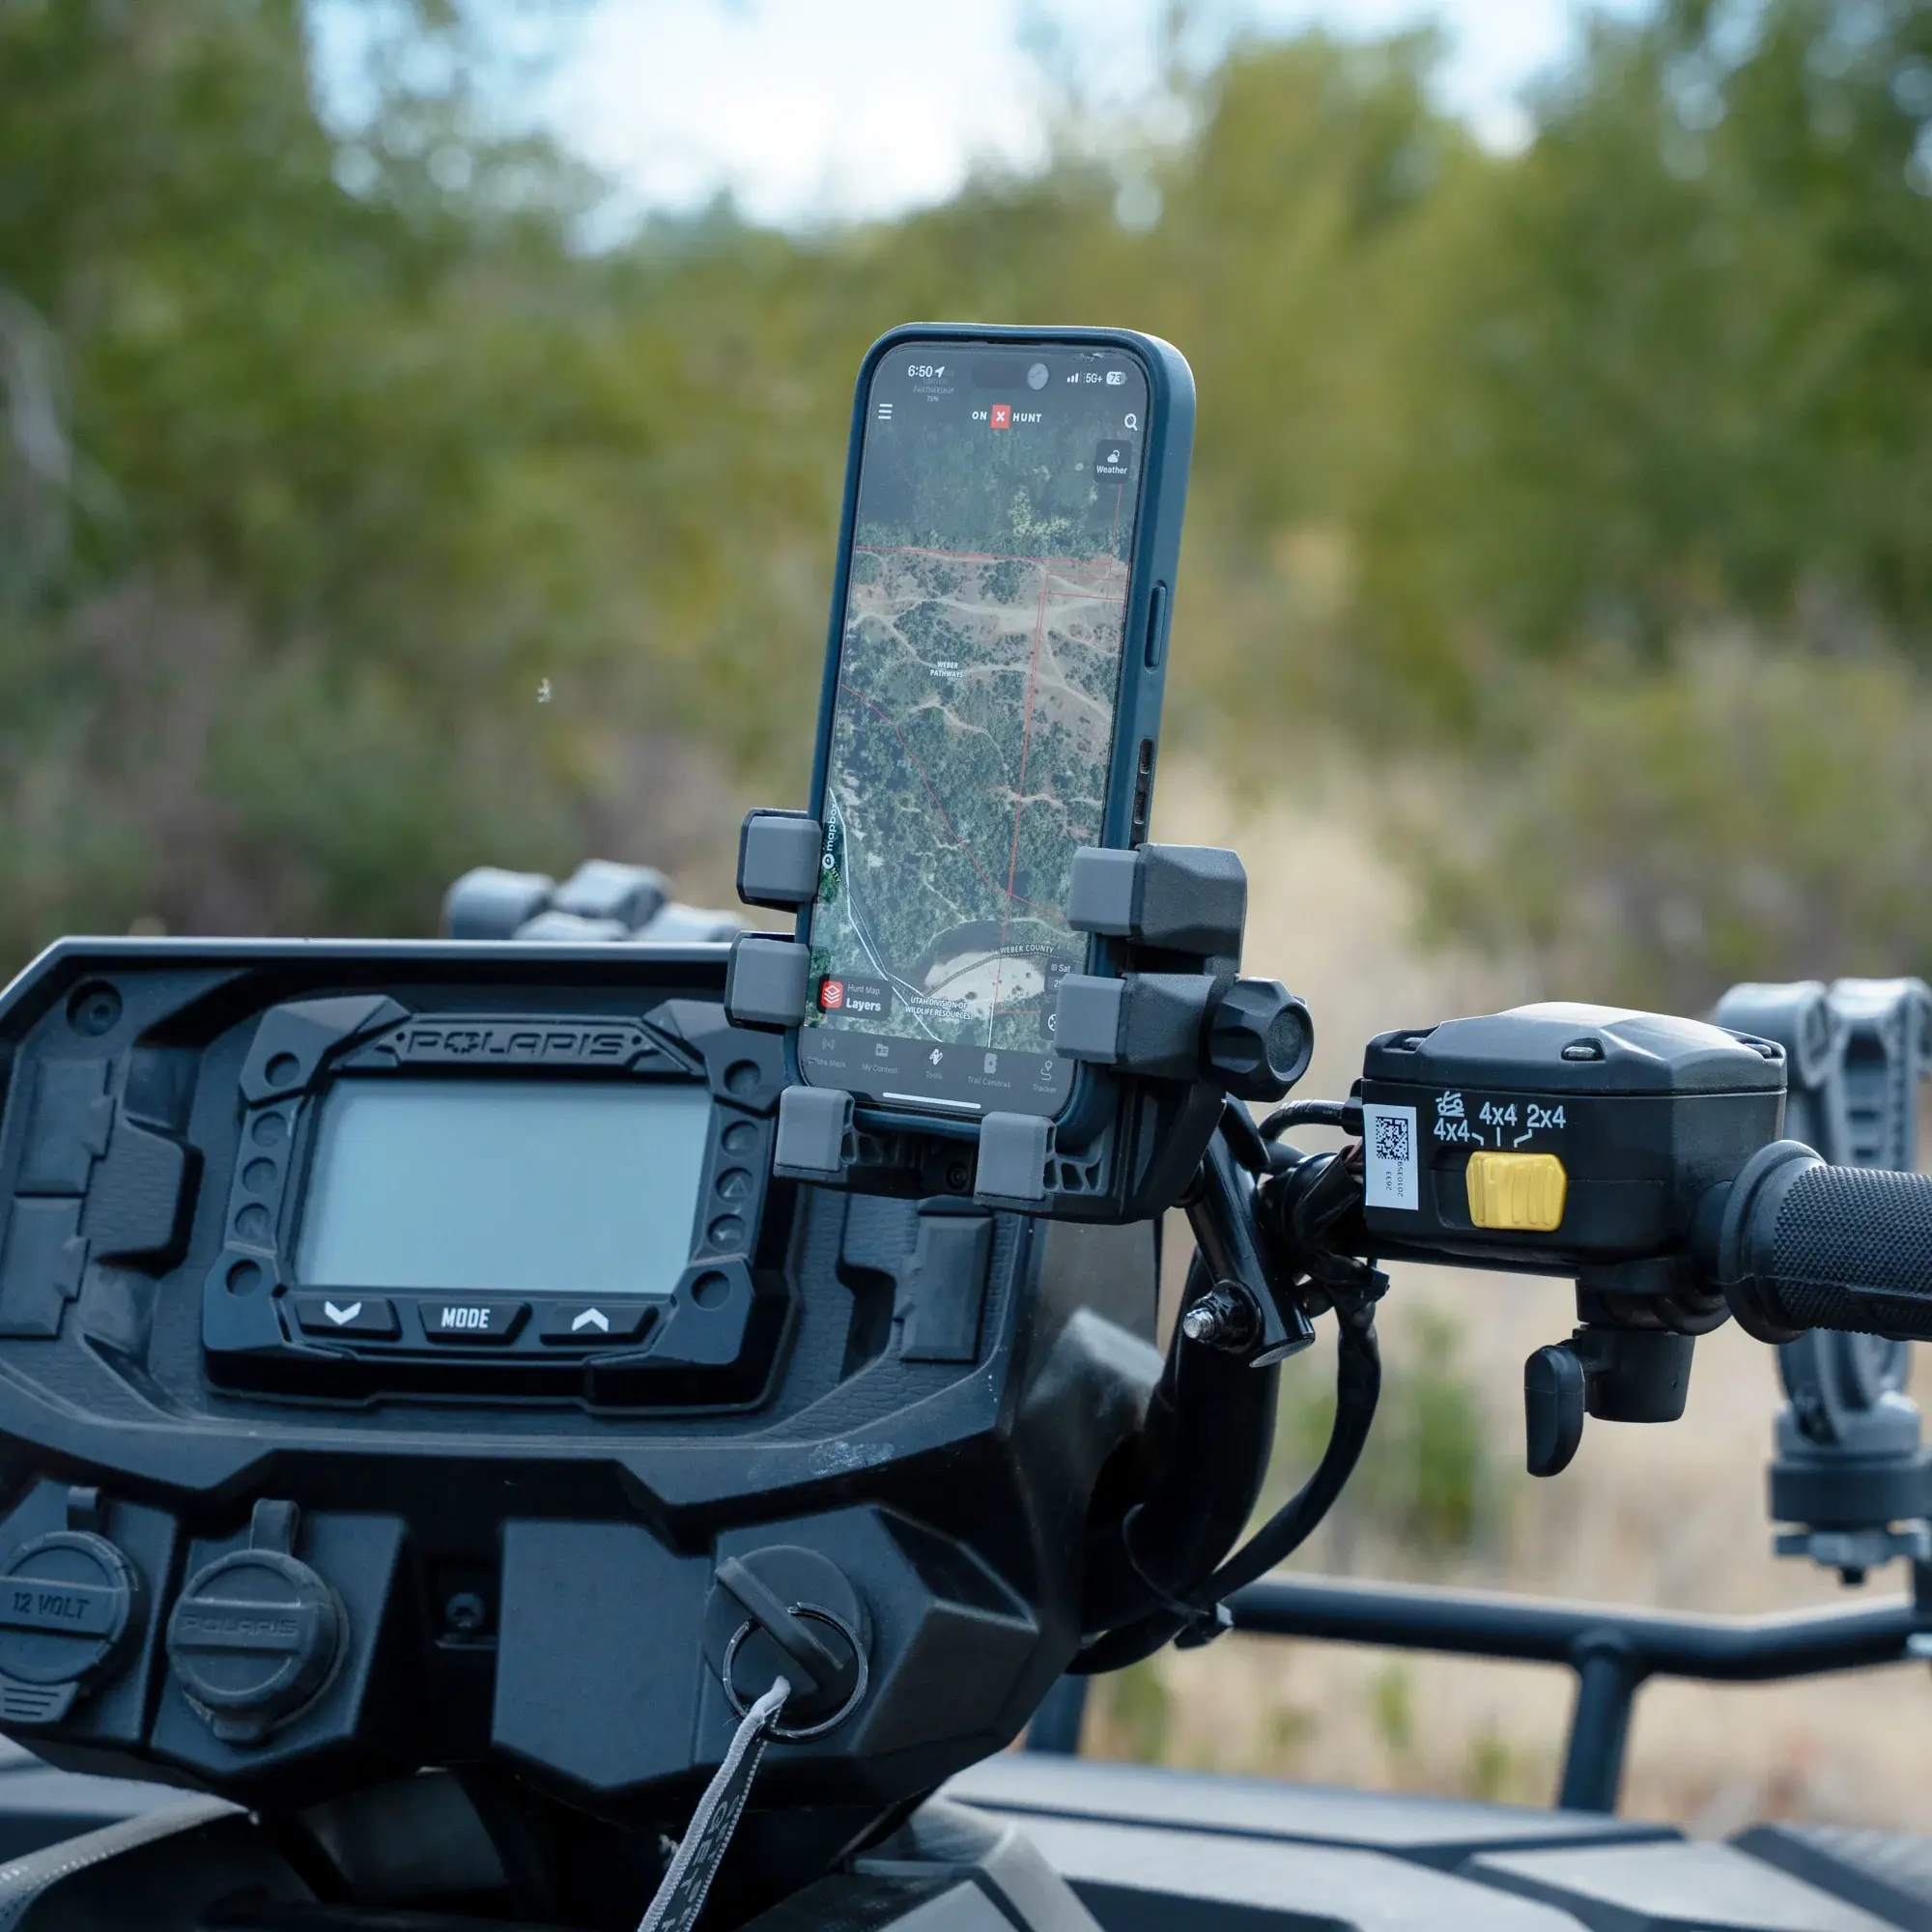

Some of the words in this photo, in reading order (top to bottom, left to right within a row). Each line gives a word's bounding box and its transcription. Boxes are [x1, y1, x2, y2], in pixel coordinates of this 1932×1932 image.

[908, 364, 933, 378] 6:50
[1086, 372, 1103, 384] 5G+
[972, 411, 987, 421] ON
[1012, 412, 1042, 423] HUNT
[1096, 465, 1128, 475] Weather
[929, 668, 964, 678] PATHWAYS
[826, 803, 838, 851] mapbox
[1000, 946, 1024, 954] WEBER
[1025, 944, 1054, 953] COUNTY
[1059, 963, 1071, 973] Sat
[847, 984, 864, 993] Hunt
[866, 985, 880, 995] Map
[846, 998, 882, 1012] Layers
[911, 996, 928, 1006] UTAH
[929, 998, 956, 1009] DIVISION
[905, 1007, 933, 1016] WILDLIFE
[934, 1009, 971, 1020] RESOURCES
[407, 1030, 625, 1057] POLARIS
[863, 1064, 871, 1072] My
[872, 1065, 898, 1074] Content
[925, 1070, 943, 1080] Tools
[968, 1075, 981, 1084] Trail
[982, 1078, 1011, 1088] Cameras
[1033, 1084, 1057, 1094] Tracker
[1479, 1101, 1518, 1126] 4x4
[1526, 1104, 1567, 1129] 2x4
[1433, 1118, 1470, 1142] 4x4
[440, 1307, 491, 1329] MODE
[13, 1591, 31, 1614] 12
[38, 1593, 91, 1620] VOLT
[182, 1613, 300, 1637] POLARIS
